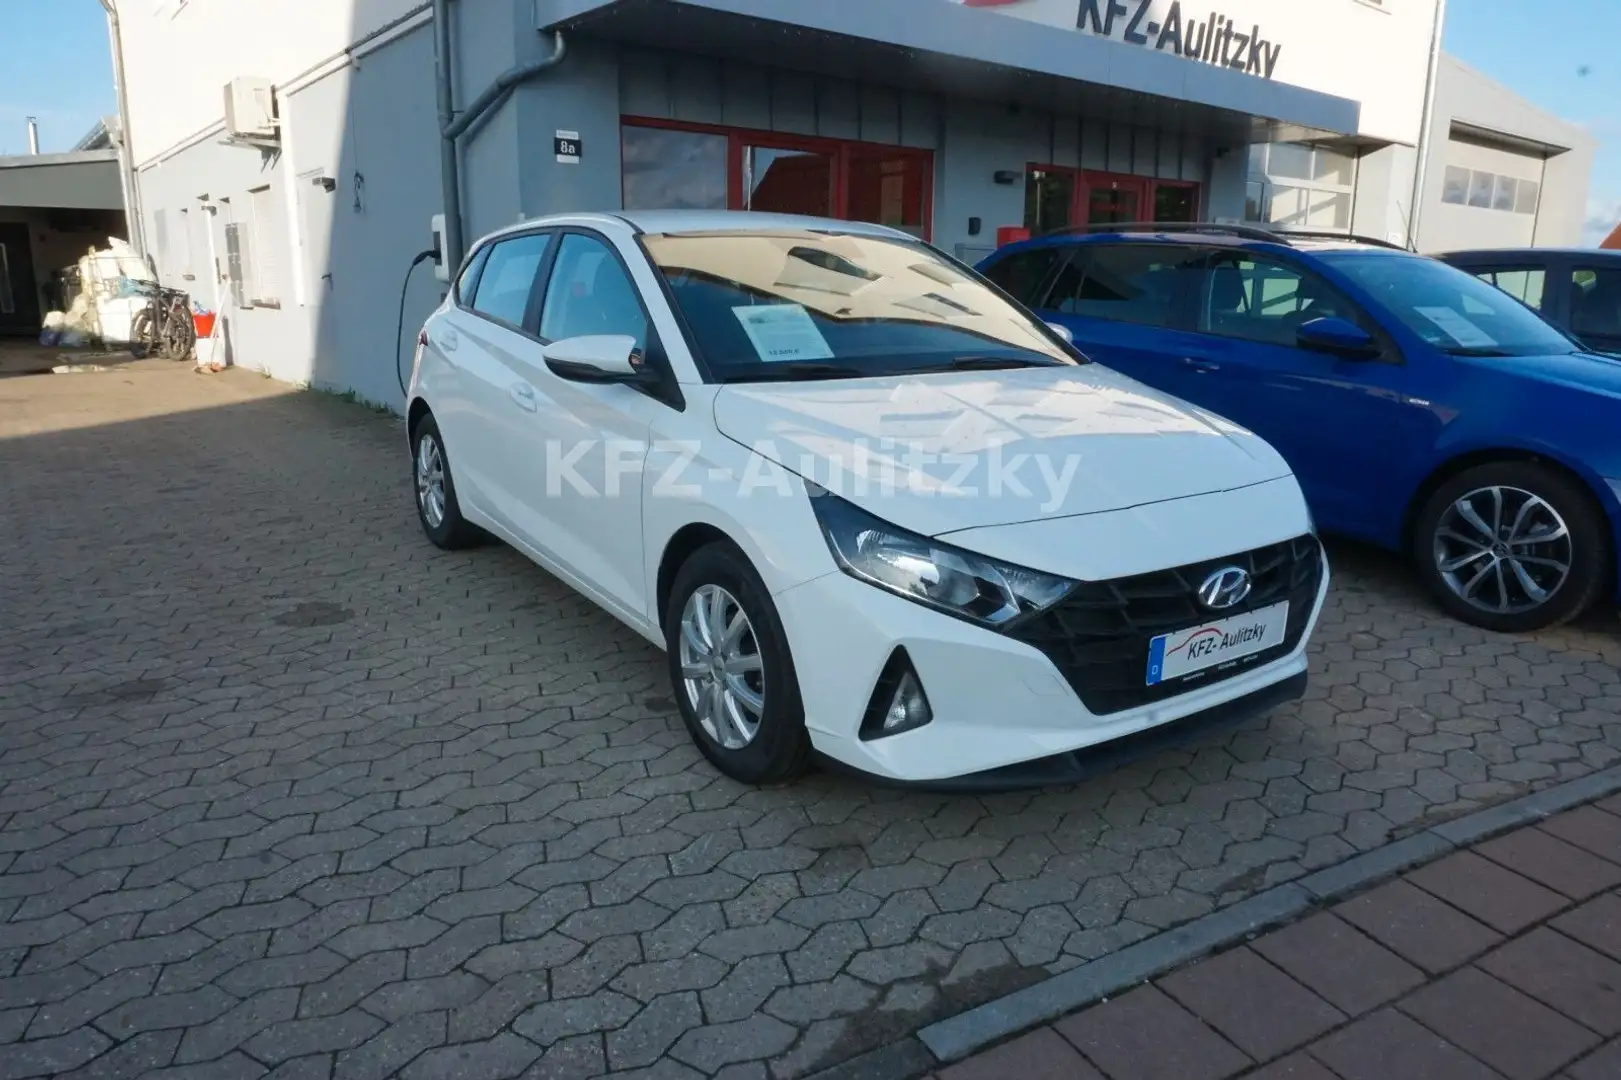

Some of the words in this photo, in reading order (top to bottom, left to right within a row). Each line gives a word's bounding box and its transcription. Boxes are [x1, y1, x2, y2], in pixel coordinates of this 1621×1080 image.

[1076, 0, 1281, 79] KFZ-Aulitzky
[560, 140, 576, 154] 8a
[1151, 664, 1159, 675] D
